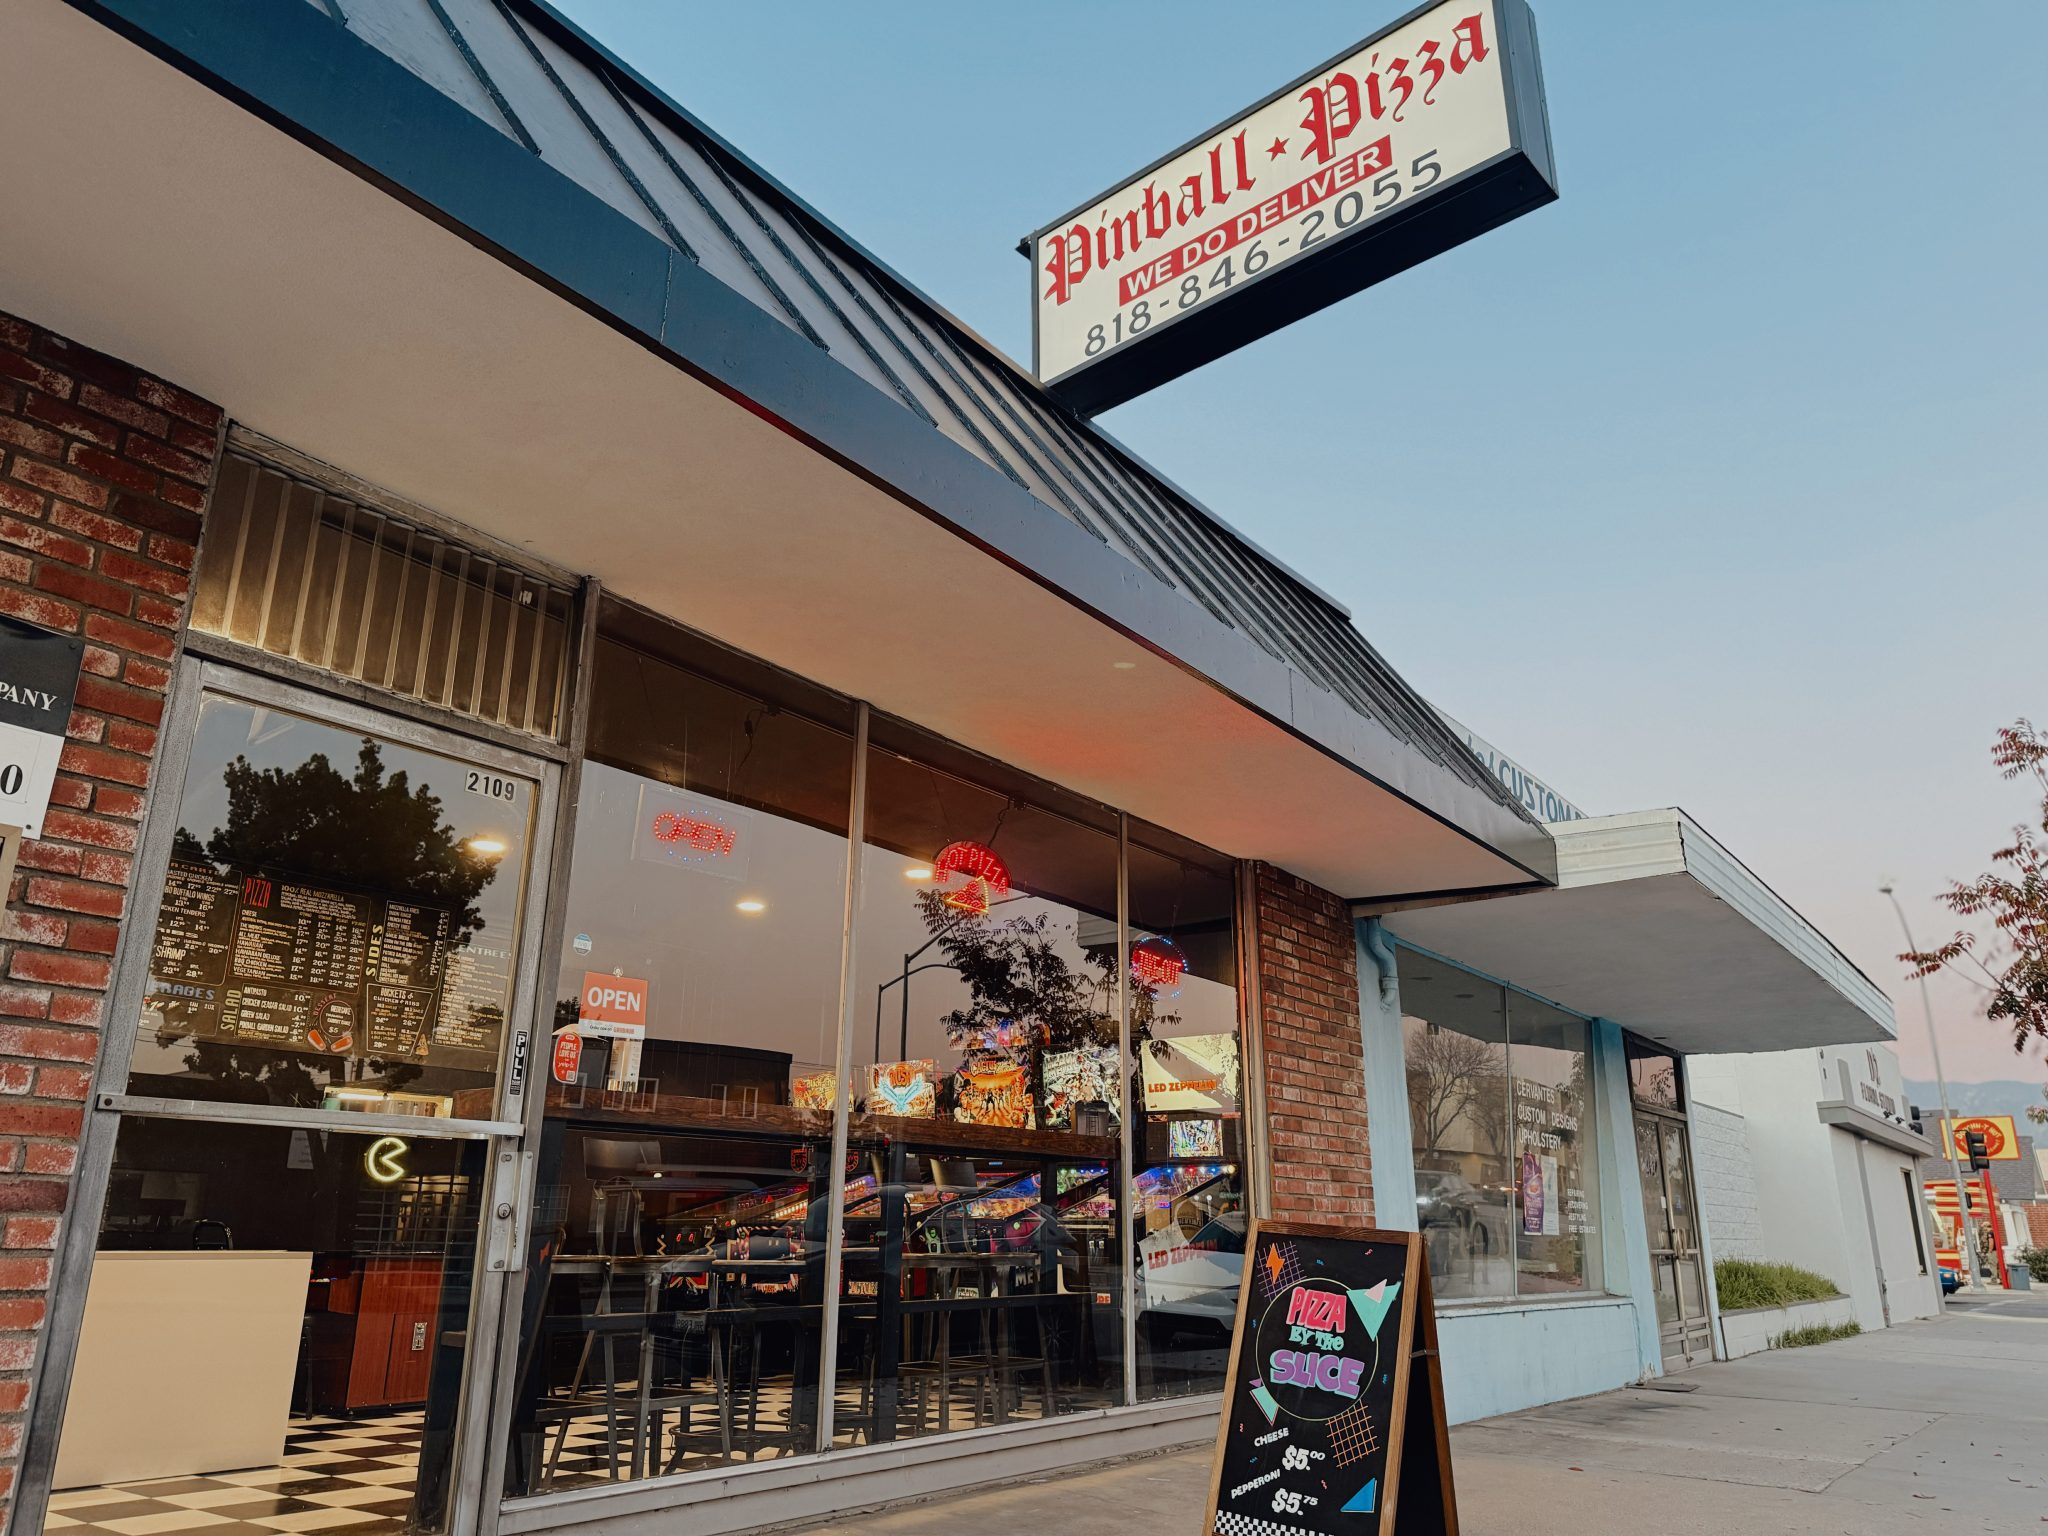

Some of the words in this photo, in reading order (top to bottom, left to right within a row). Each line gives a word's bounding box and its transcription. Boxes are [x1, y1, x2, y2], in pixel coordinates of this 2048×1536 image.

[1043, 127, 1257, 306] Pinball
[1300, 12, 1491, 165] Pizza
[1126, 263, 1174, 300] WE
[1182, 229, 1227, 268] DO
[1237, 144, 1385, 240] DELIVER
[1084, 149, 1443, 358] 818-846-2055
[468, 772, 515, 801] 2109
[654, 813, 736, 856] OPEN
[968, 848, 1008, 897] PIZZA
[243, 878, 271, 908] PIZZA
[155, 945, 187, 961] SHRIMP
[365, 924, 383, 977] SIDES
[221, 989, 242, 1031] SALAD
[587, 986, 641, 1012] OPEN
[513, 1035, 526, 1080] PULL
[1148, 1083, 1167, 1094] LED
[1169, 1080, 1218, 1092] ZEPPELIN
[1516, 1080, 1555, 1104] CERVANTES
[1517, 1103, 1546, 1125] CUSTOM
[1551, 1111, 1578, 1132] DESIGNS
[1518, 1127, 1561, 1150] UPHOLSTERY
[1148, 1249, 1169, 1271] LED
[1286, 1286, 1348, 1333] PIZZA
[1288, 1325, 1315, 1347] BY
[1270, 1349, 1365, 1400] SLICE
[1254, 1427, 1289, 1447] CHEESE
[1281, 1445, 1326, 1471] $5.00
[1231, 1469, 1281, 1499] PEPPERONI
[1271, 1487, 1319, 1516] $5.75
